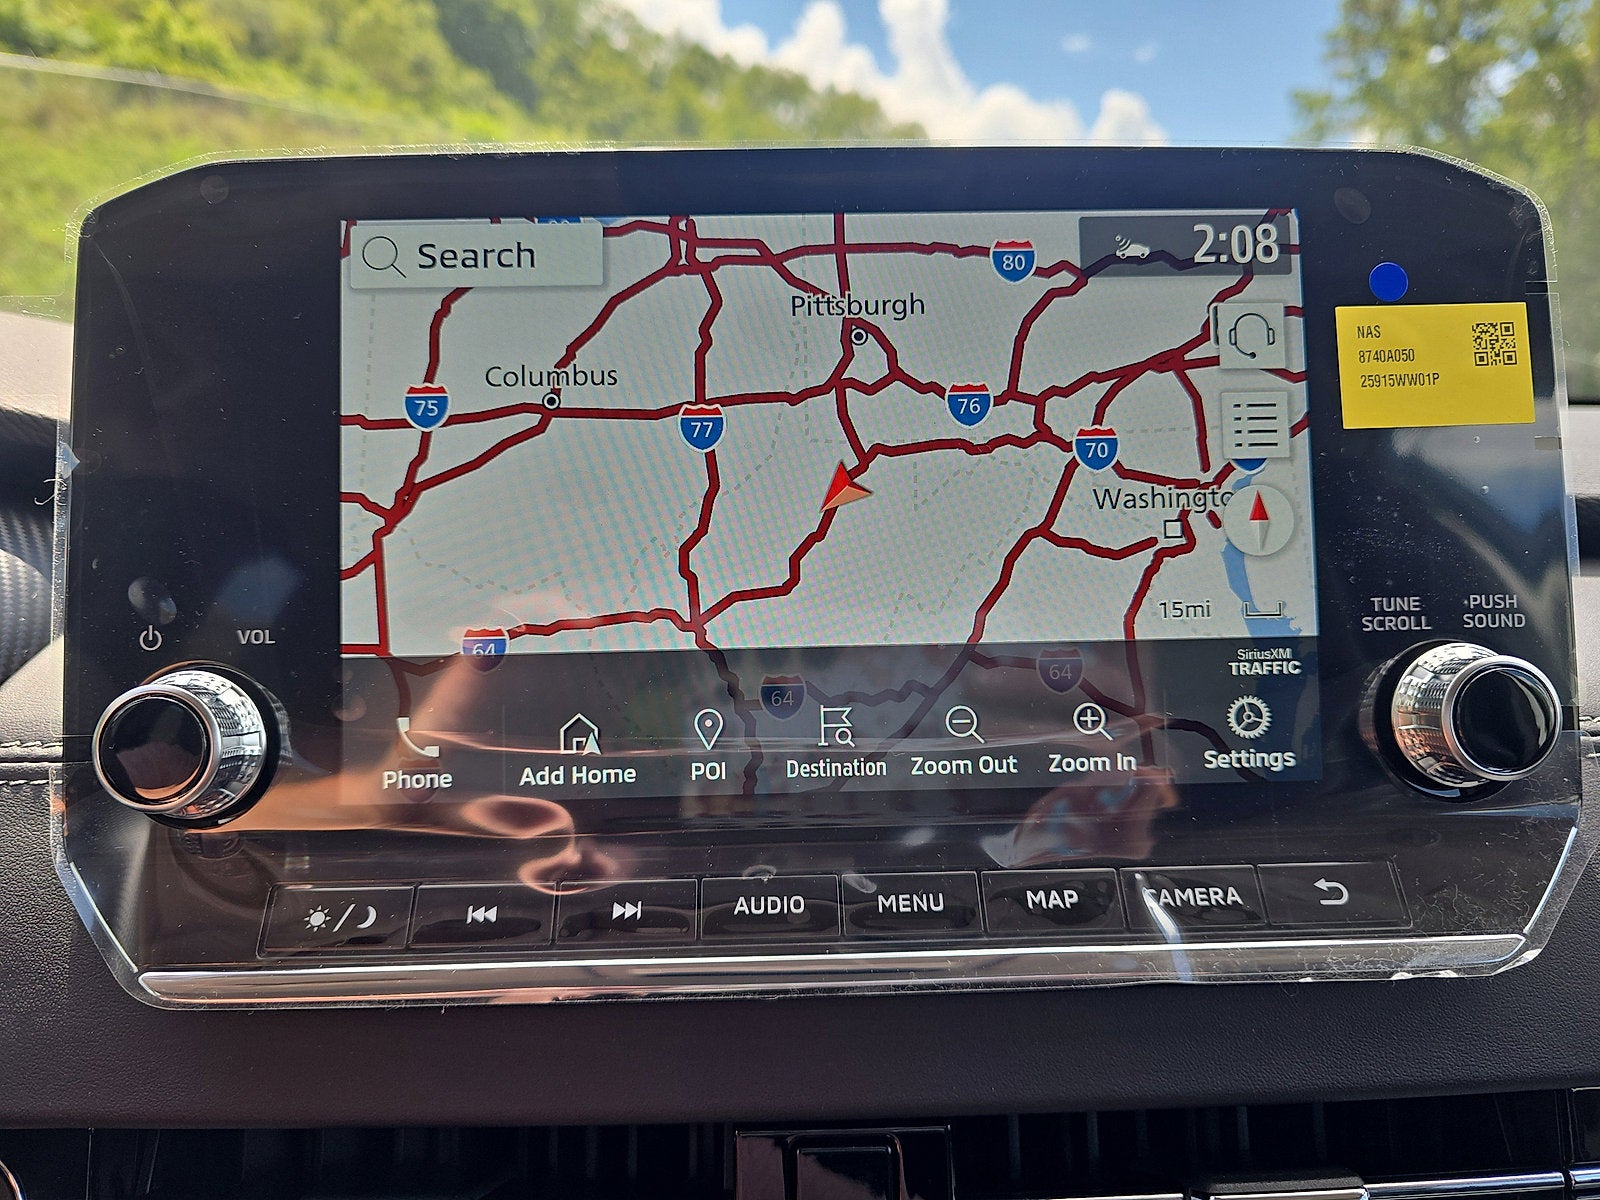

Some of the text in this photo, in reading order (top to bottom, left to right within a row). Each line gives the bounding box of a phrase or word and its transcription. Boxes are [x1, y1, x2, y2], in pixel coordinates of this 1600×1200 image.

[1193, 223, 1279, 265] 2:08
[418, 242, 536, 269] Search
[1002, 254, 1026, 271] 80
[791, 292, 925, 320] Pittsburgh
[1357, 325, 1381, 338] NAS
[1358, 348, 1415, 363] 8740A050
[485, 364, 618, 387] Columbus
[1360, 373, 1440, 388] 25915WW01P
[415, 400, 439, 416] 75
[958, 398, 981, 415] 76
[690, 421, 713, 438] 77
[1085, 442, 1109, 459] 70
[1158, 600, 1212, 618] 15mi
[1370, 596, 1421, 611] TUNE
[1469, 594, 1518, 609] PUSH
[1362, 615, 1432, 631] SCROLL
[1463, 613, 1526, 628] SOUND
[236, 629, 276, 645] VOL
[473, 643, 496, 658] 64
[1237, 648, 1292, 660] SiriusXM
[1049, 664, 1072, 680] 64
[1228, 661, 1302, 676] TRAFFIC
[770, 690, 795, 707] 64
[786, 758, 887, 778] Destination
[911, 754, 1018, 776] Zoom Out
[1049, 752, 1137, 773] Zoom In
[1203, 749, 1297, 771] Settings
[382, 770, 453, 789] Phone
[518, 765, 637, 786] Add Home
[691, 762, 727, 781] POI
[733, 895, 805, 915] AUDIO
[877, 892, 944, 913] MENU
[1026, 889, 1079, 910] MAP
